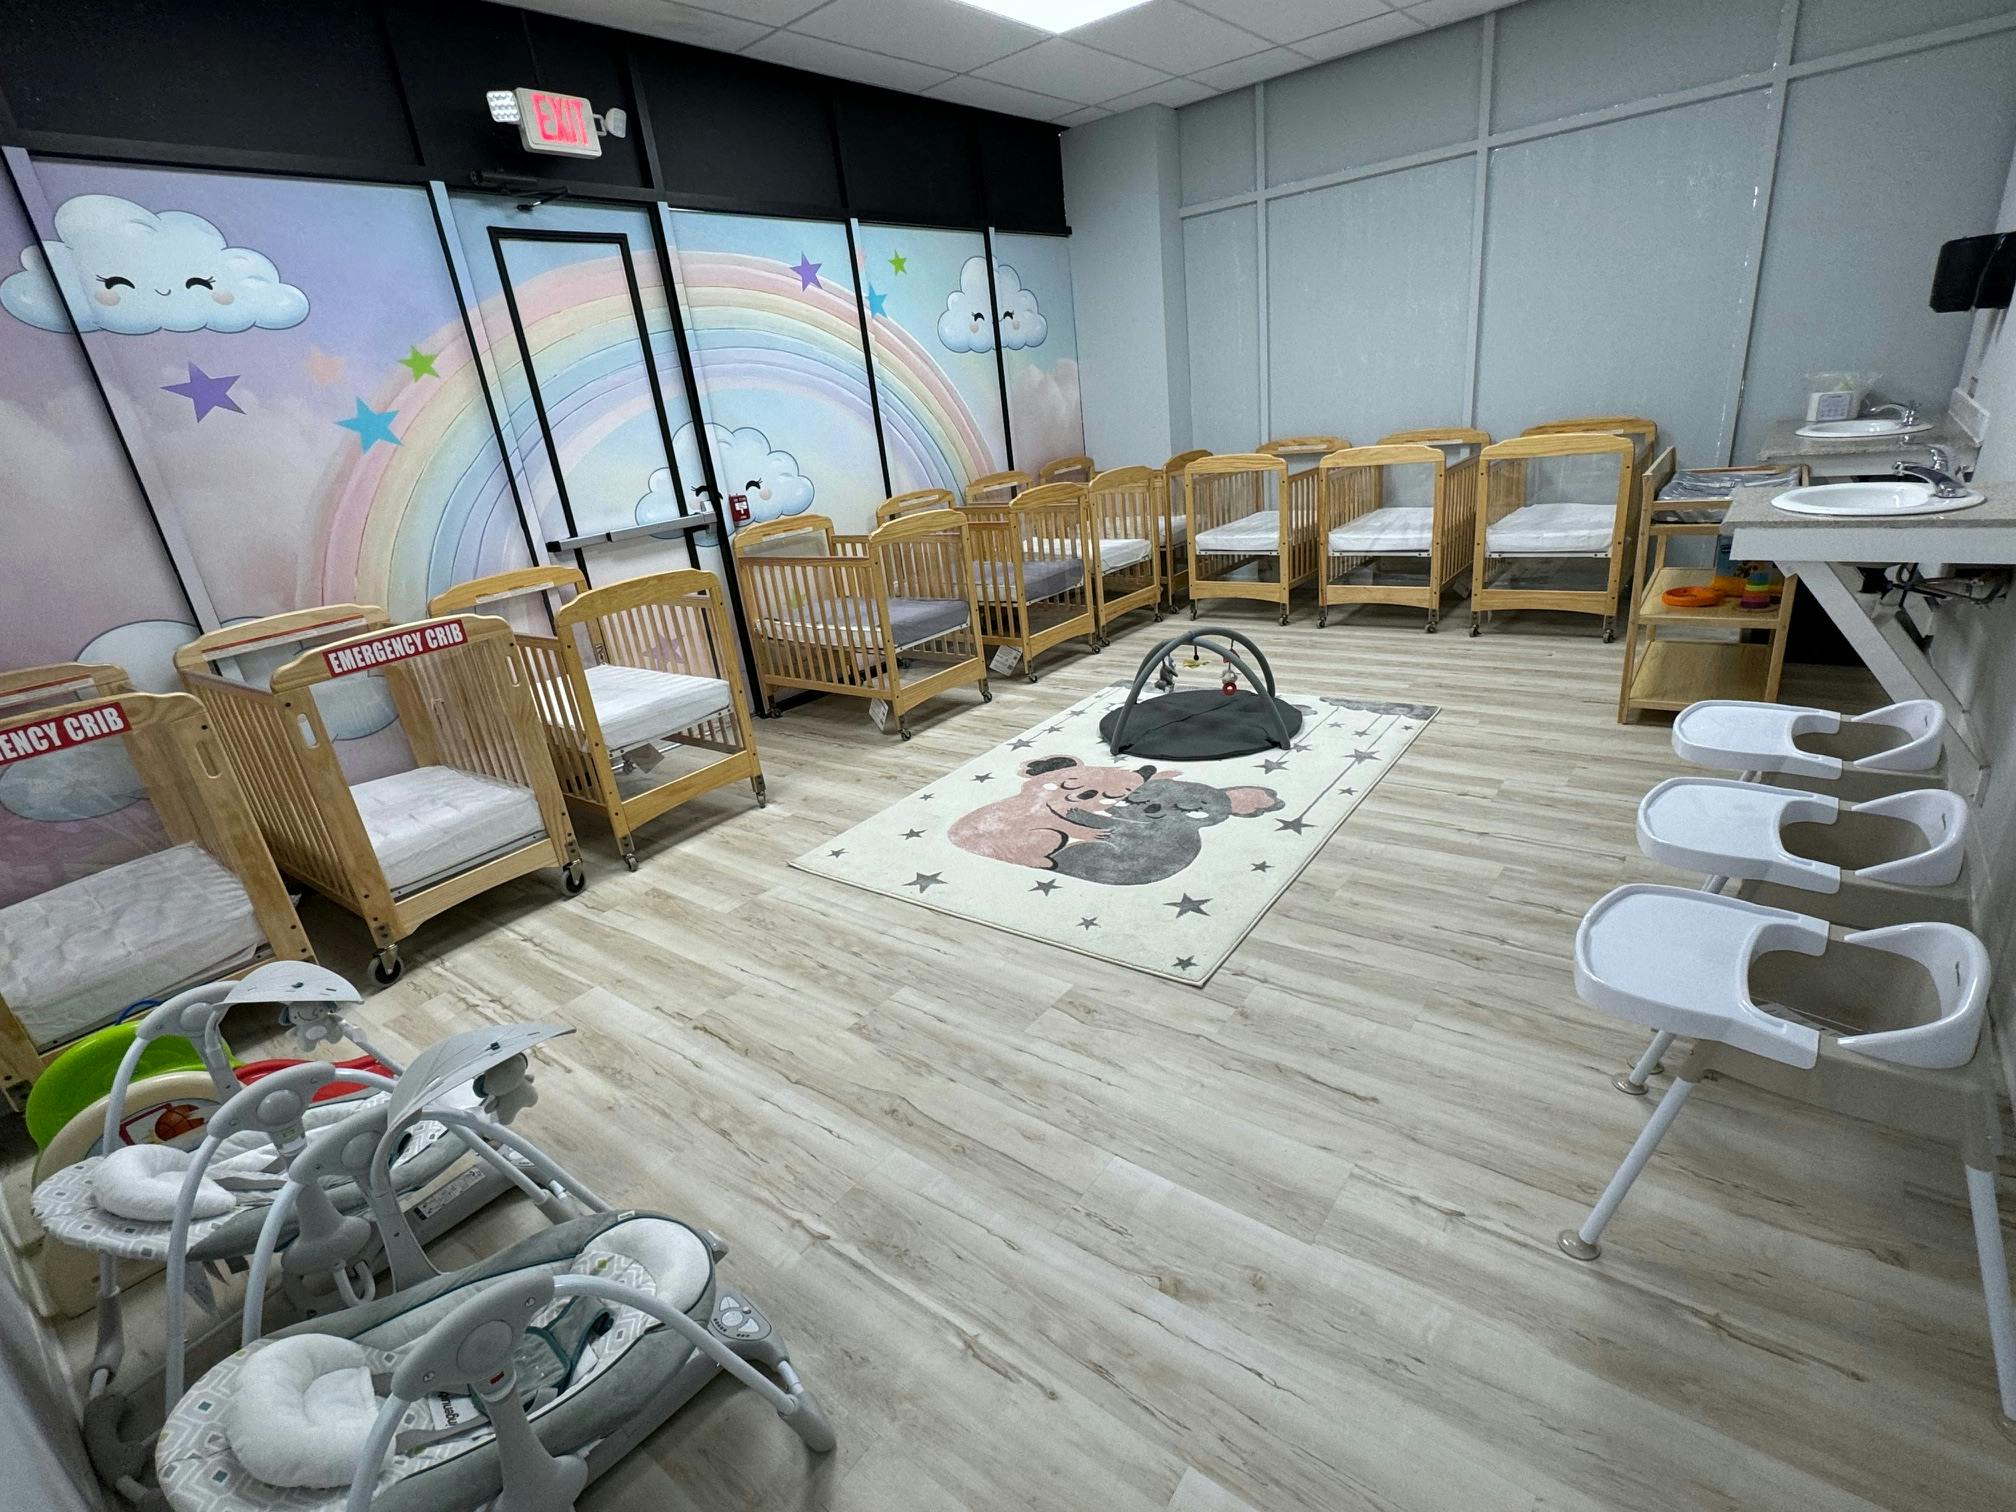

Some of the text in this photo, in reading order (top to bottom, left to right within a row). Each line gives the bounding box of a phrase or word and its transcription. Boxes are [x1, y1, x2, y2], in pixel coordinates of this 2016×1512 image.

[531, 93, 588, 145] EXIT
[328, 623, 464, 674] EMERGENCY CRIB
[0, 707, 125, 761] ENCY CRIB
